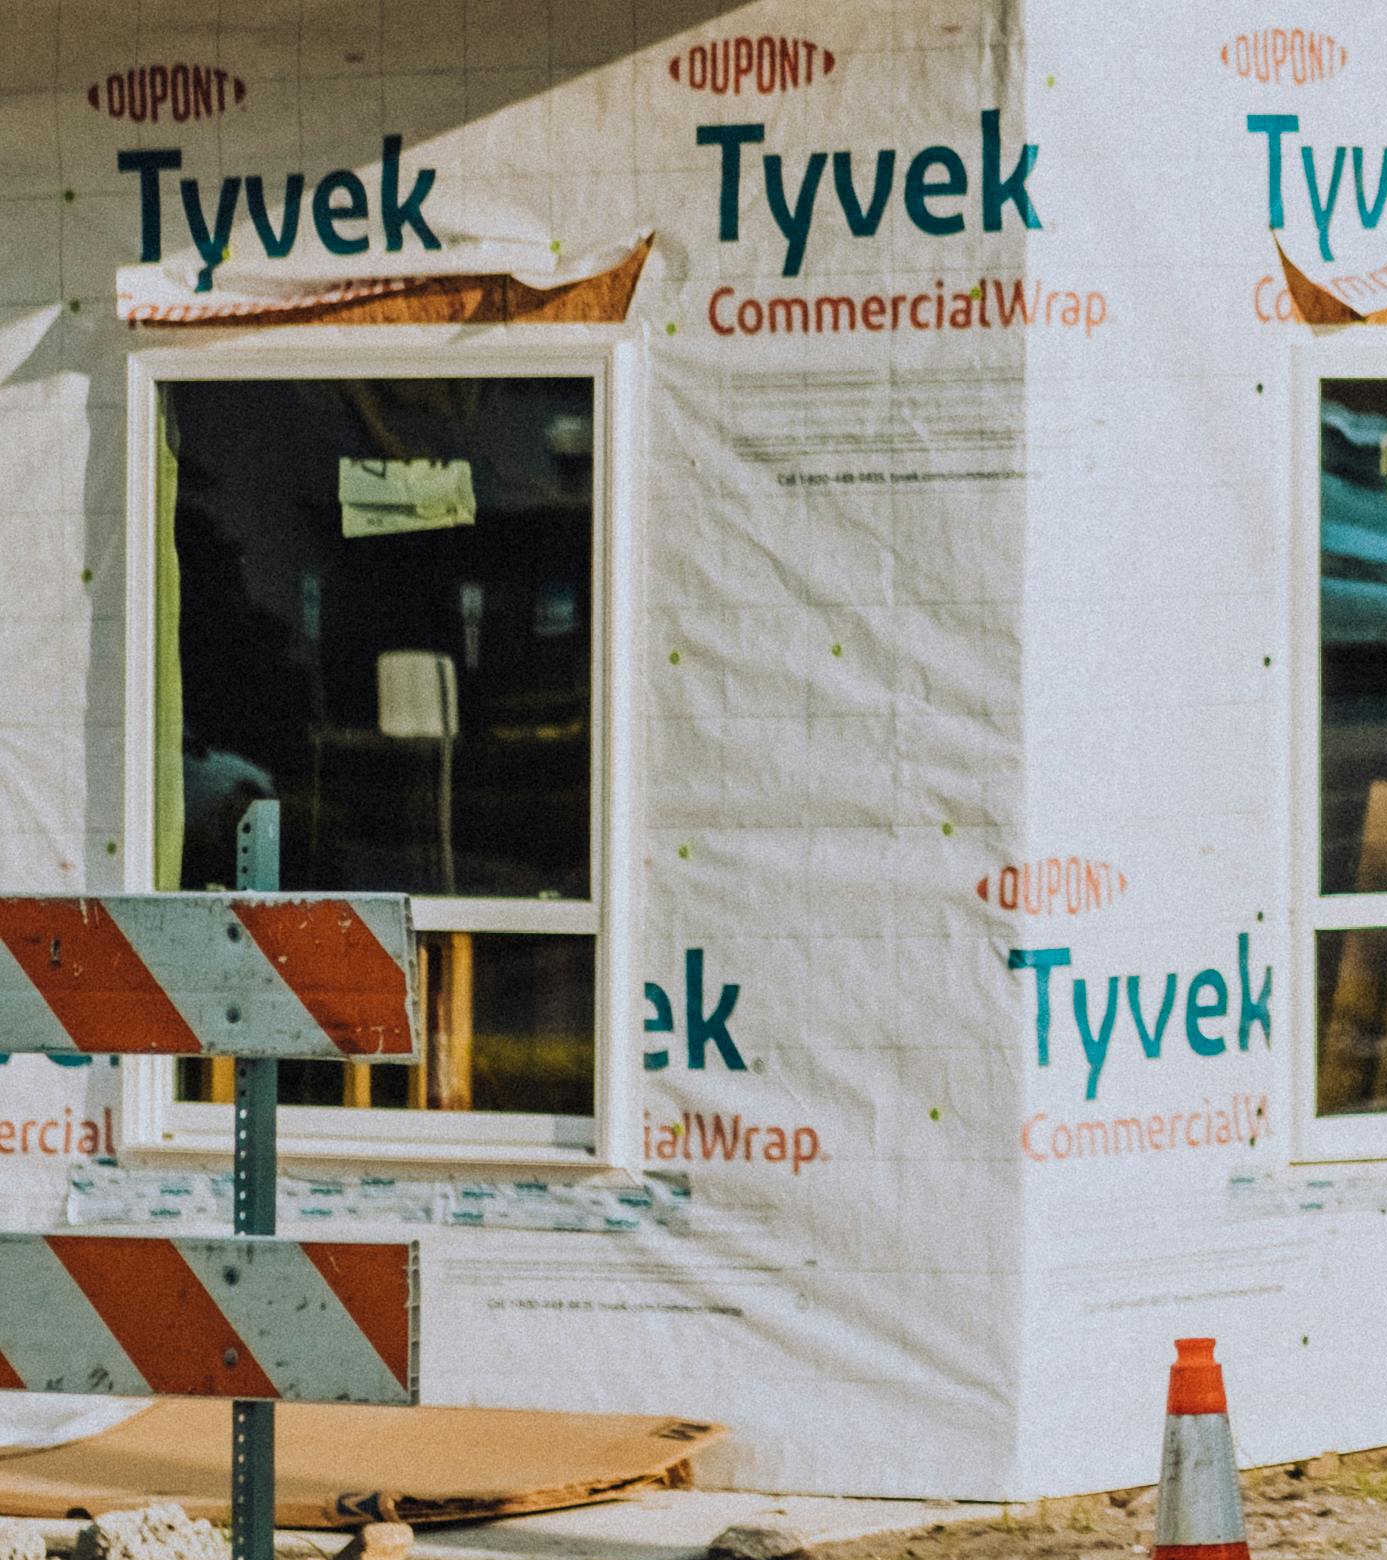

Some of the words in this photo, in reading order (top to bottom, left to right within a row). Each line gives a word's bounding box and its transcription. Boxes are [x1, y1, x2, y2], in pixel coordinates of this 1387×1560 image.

[689, 36, 816, 96] DUPONT
[1236, 28, 1337, 84] DUPONT
[105, 63, 232, 122] DUPONT
[118, 136, 441, 292] Tyvek
[696, 111, 1041, 276] Tyvek
[708, 276, 1107, 341] CommercialWrap
[1000, 856, 1113, 917] DUPONT
